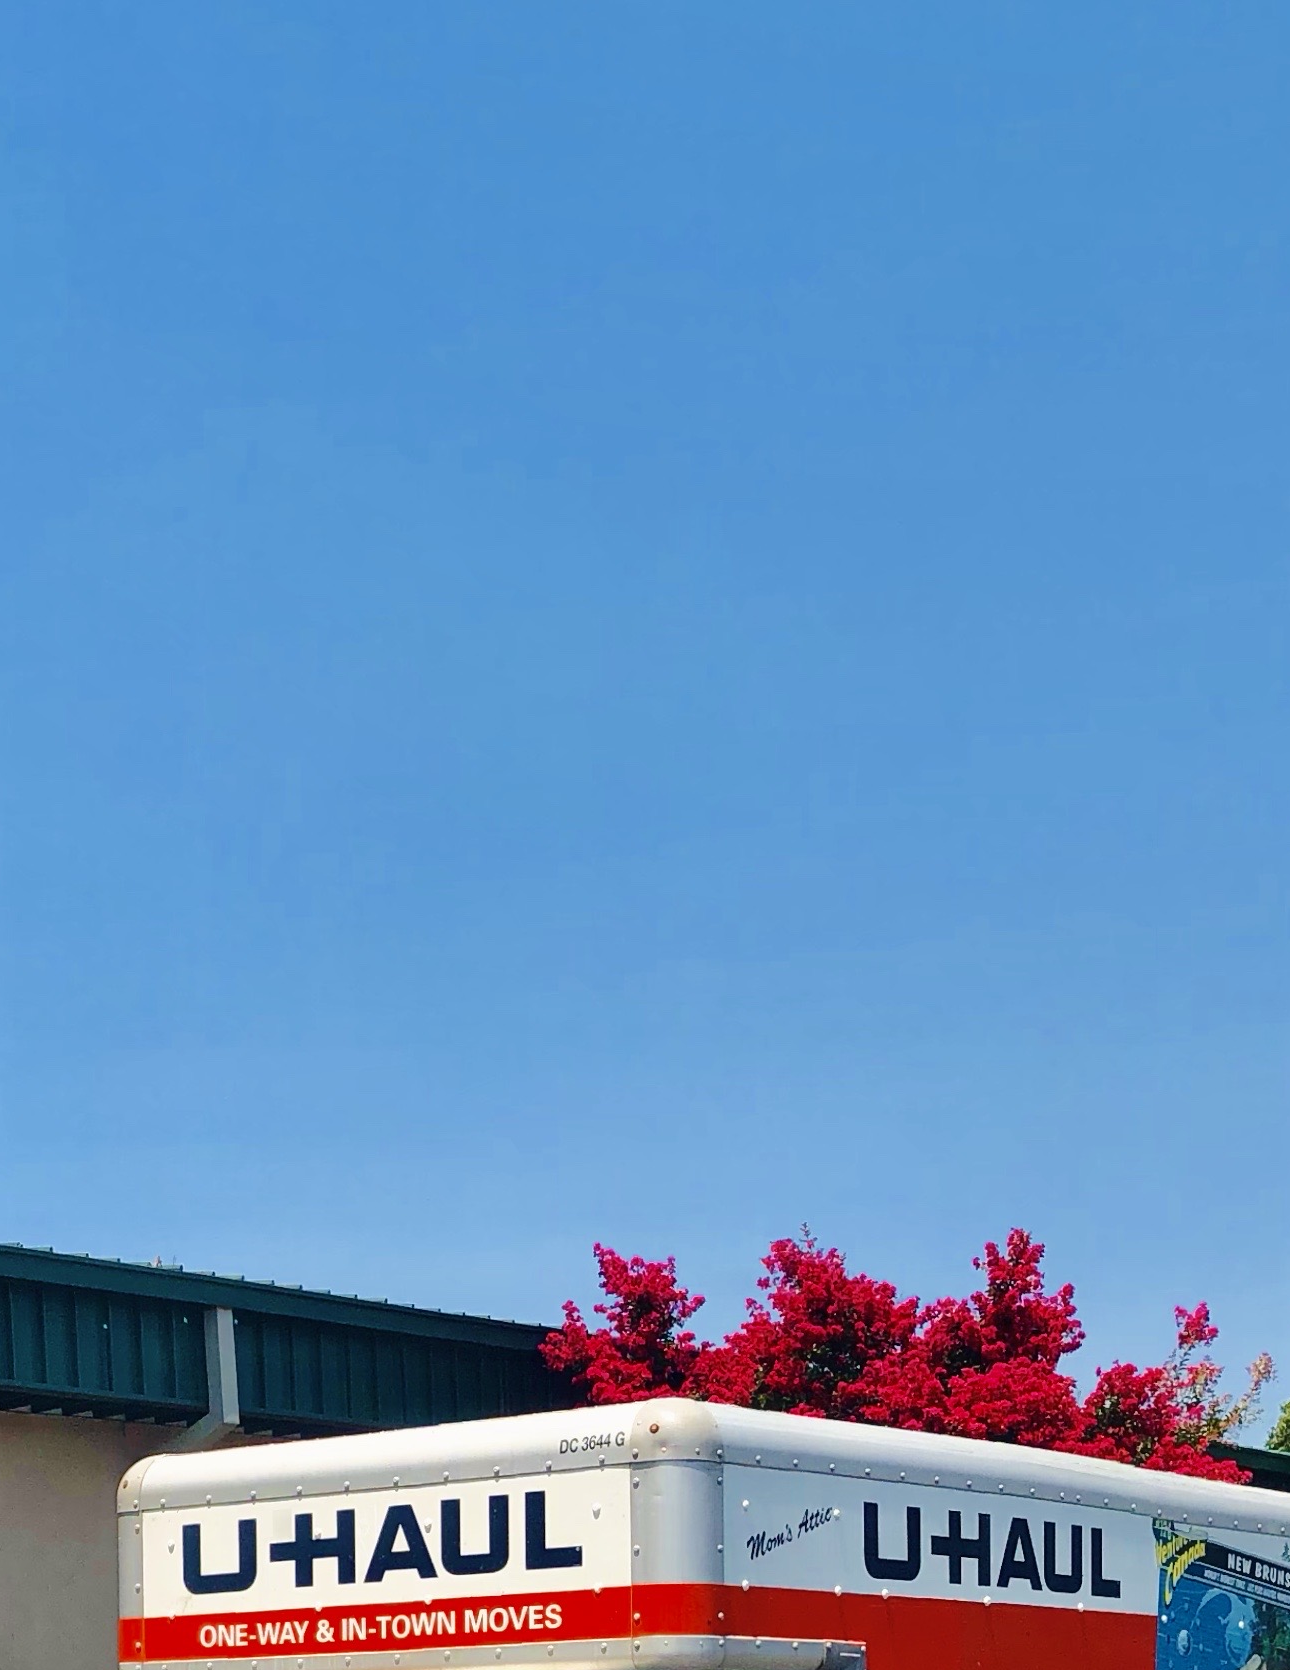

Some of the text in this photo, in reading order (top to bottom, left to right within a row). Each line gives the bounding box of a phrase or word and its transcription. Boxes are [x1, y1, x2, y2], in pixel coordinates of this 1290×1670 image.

[559, 1431, 625, 1454] DC 3644 G
[746, 1507, 833, 1560] Mom's Attic
[1227, 1552, 1252, 1575] NEW
[199, 1604, 563, 1649] ONE-WAY & IN-TOWN MOVES
